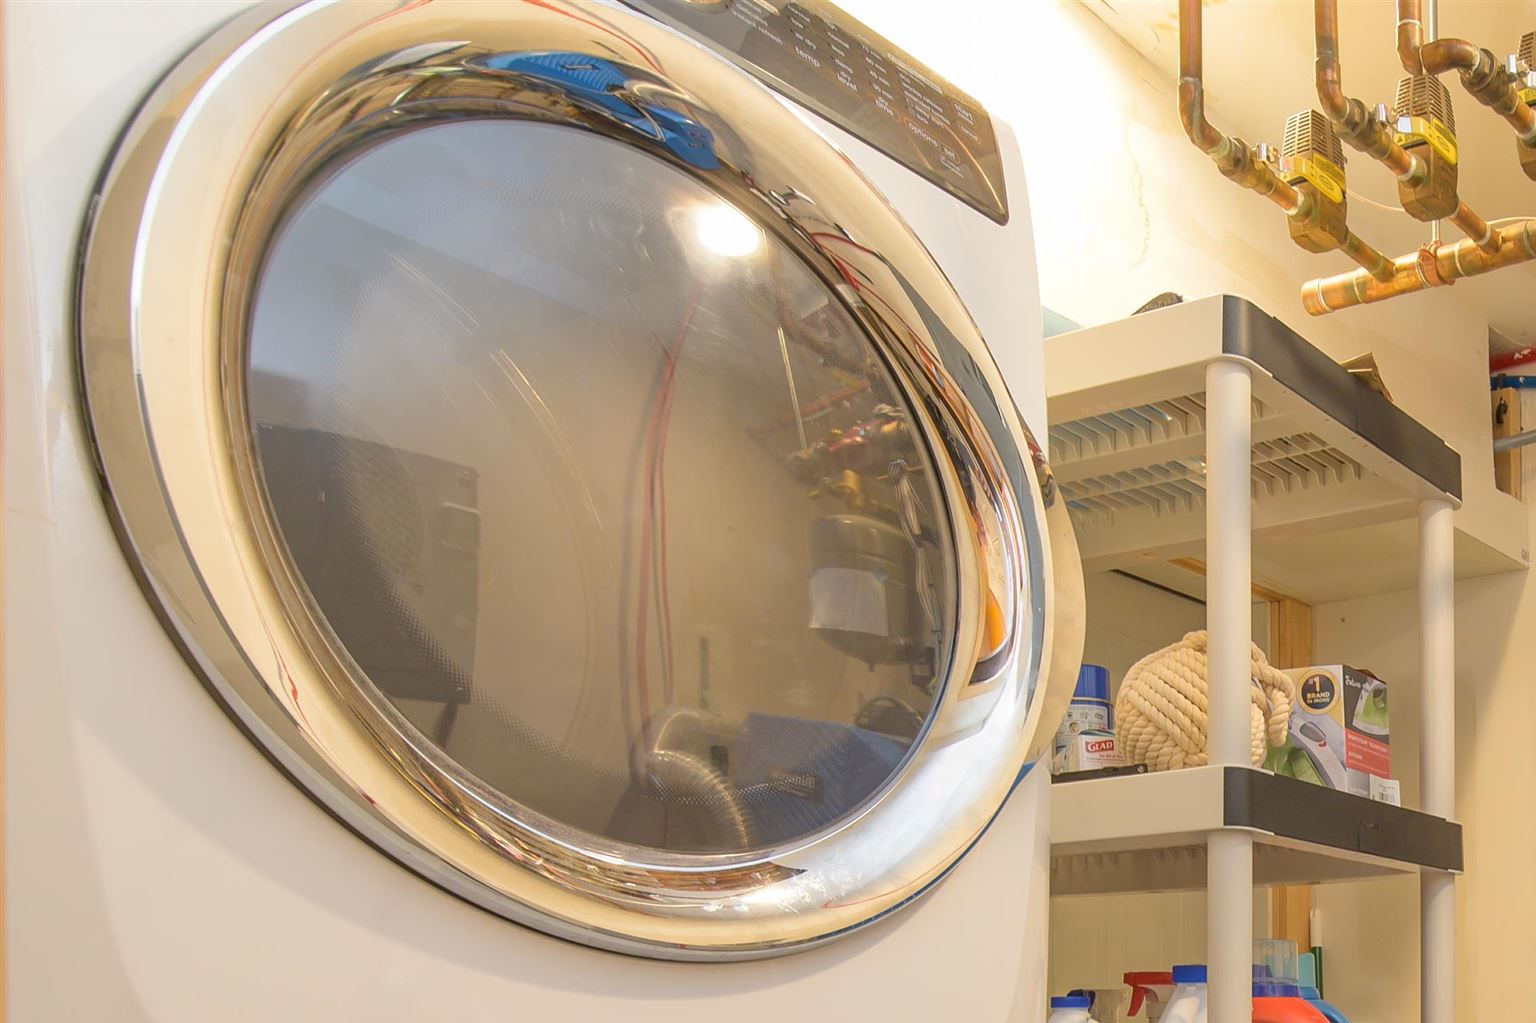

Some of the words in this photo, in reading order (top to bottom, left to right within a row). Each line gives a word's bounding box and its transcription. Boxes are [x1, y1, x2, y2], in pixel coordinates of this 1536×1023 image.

[795, 47, 821, 68] temp
[908, 122, 939, 148] options
[1306, 691, 1331, 701] BRAND
[1087, 741, 1113, 752] GLAD
